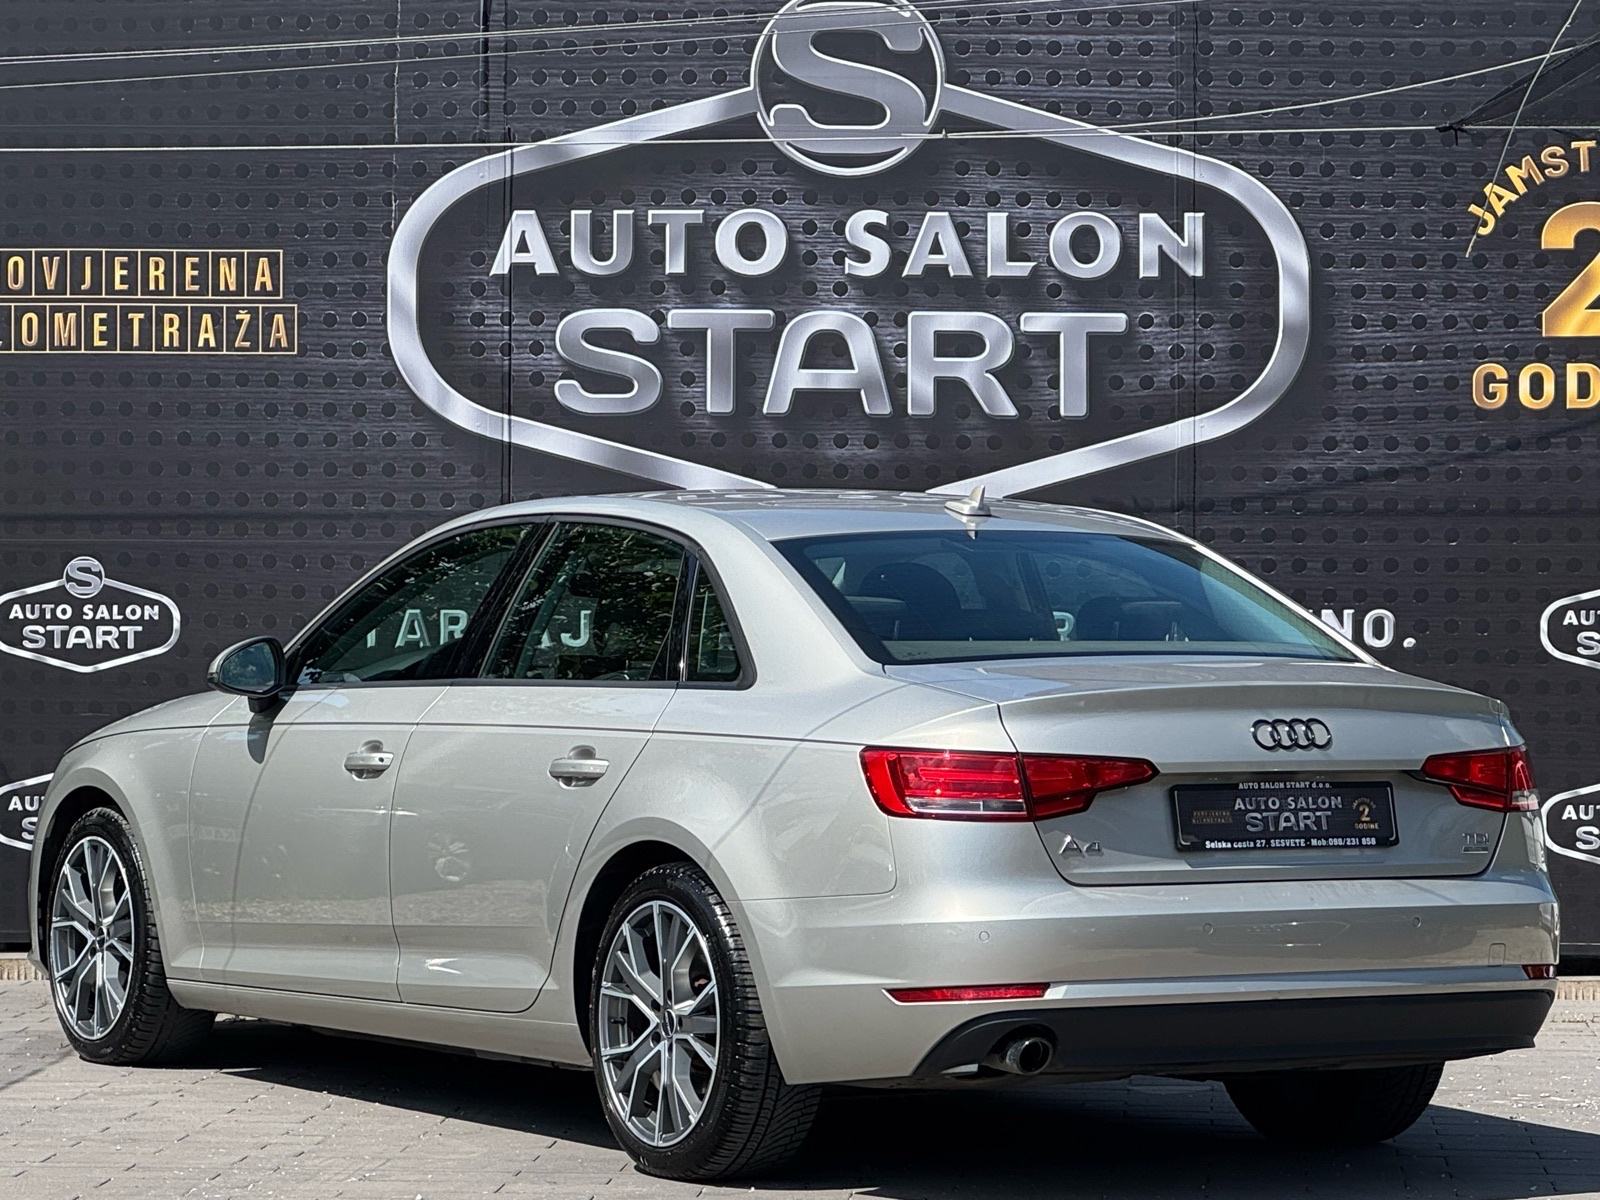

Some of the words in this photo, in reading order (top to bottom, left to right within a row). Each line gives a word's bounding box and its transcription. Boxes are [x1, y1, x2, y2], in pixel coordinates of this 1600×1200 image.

[489, 208, 788, 276] AUTO
[844, 209, 1205, 279] SALON
[7, 256, 274, 292] OVJERENA
[0, 310, 289, 348] OMETRAŽA
[554, 308, 1128, 418] START
[9, 604, 73, 620] AUTO
[82, 604, 160, 620] SALON
[1562, 609, 1600, 626] AU
[22, 625, 143, 649] START
[1286, 781, 1310, 789] START
[8, 795, 45, 812] AU
[1234, 797, 1280, 811] AUTO
[1287, 796, 1343, 809] SALON
[1562, 804, 1600, 821] AU
[1245, 811, 1332, 832] START
[1059, 834, 1104, 857] A4
[1270, 838, 1306, 848] SESVETE
